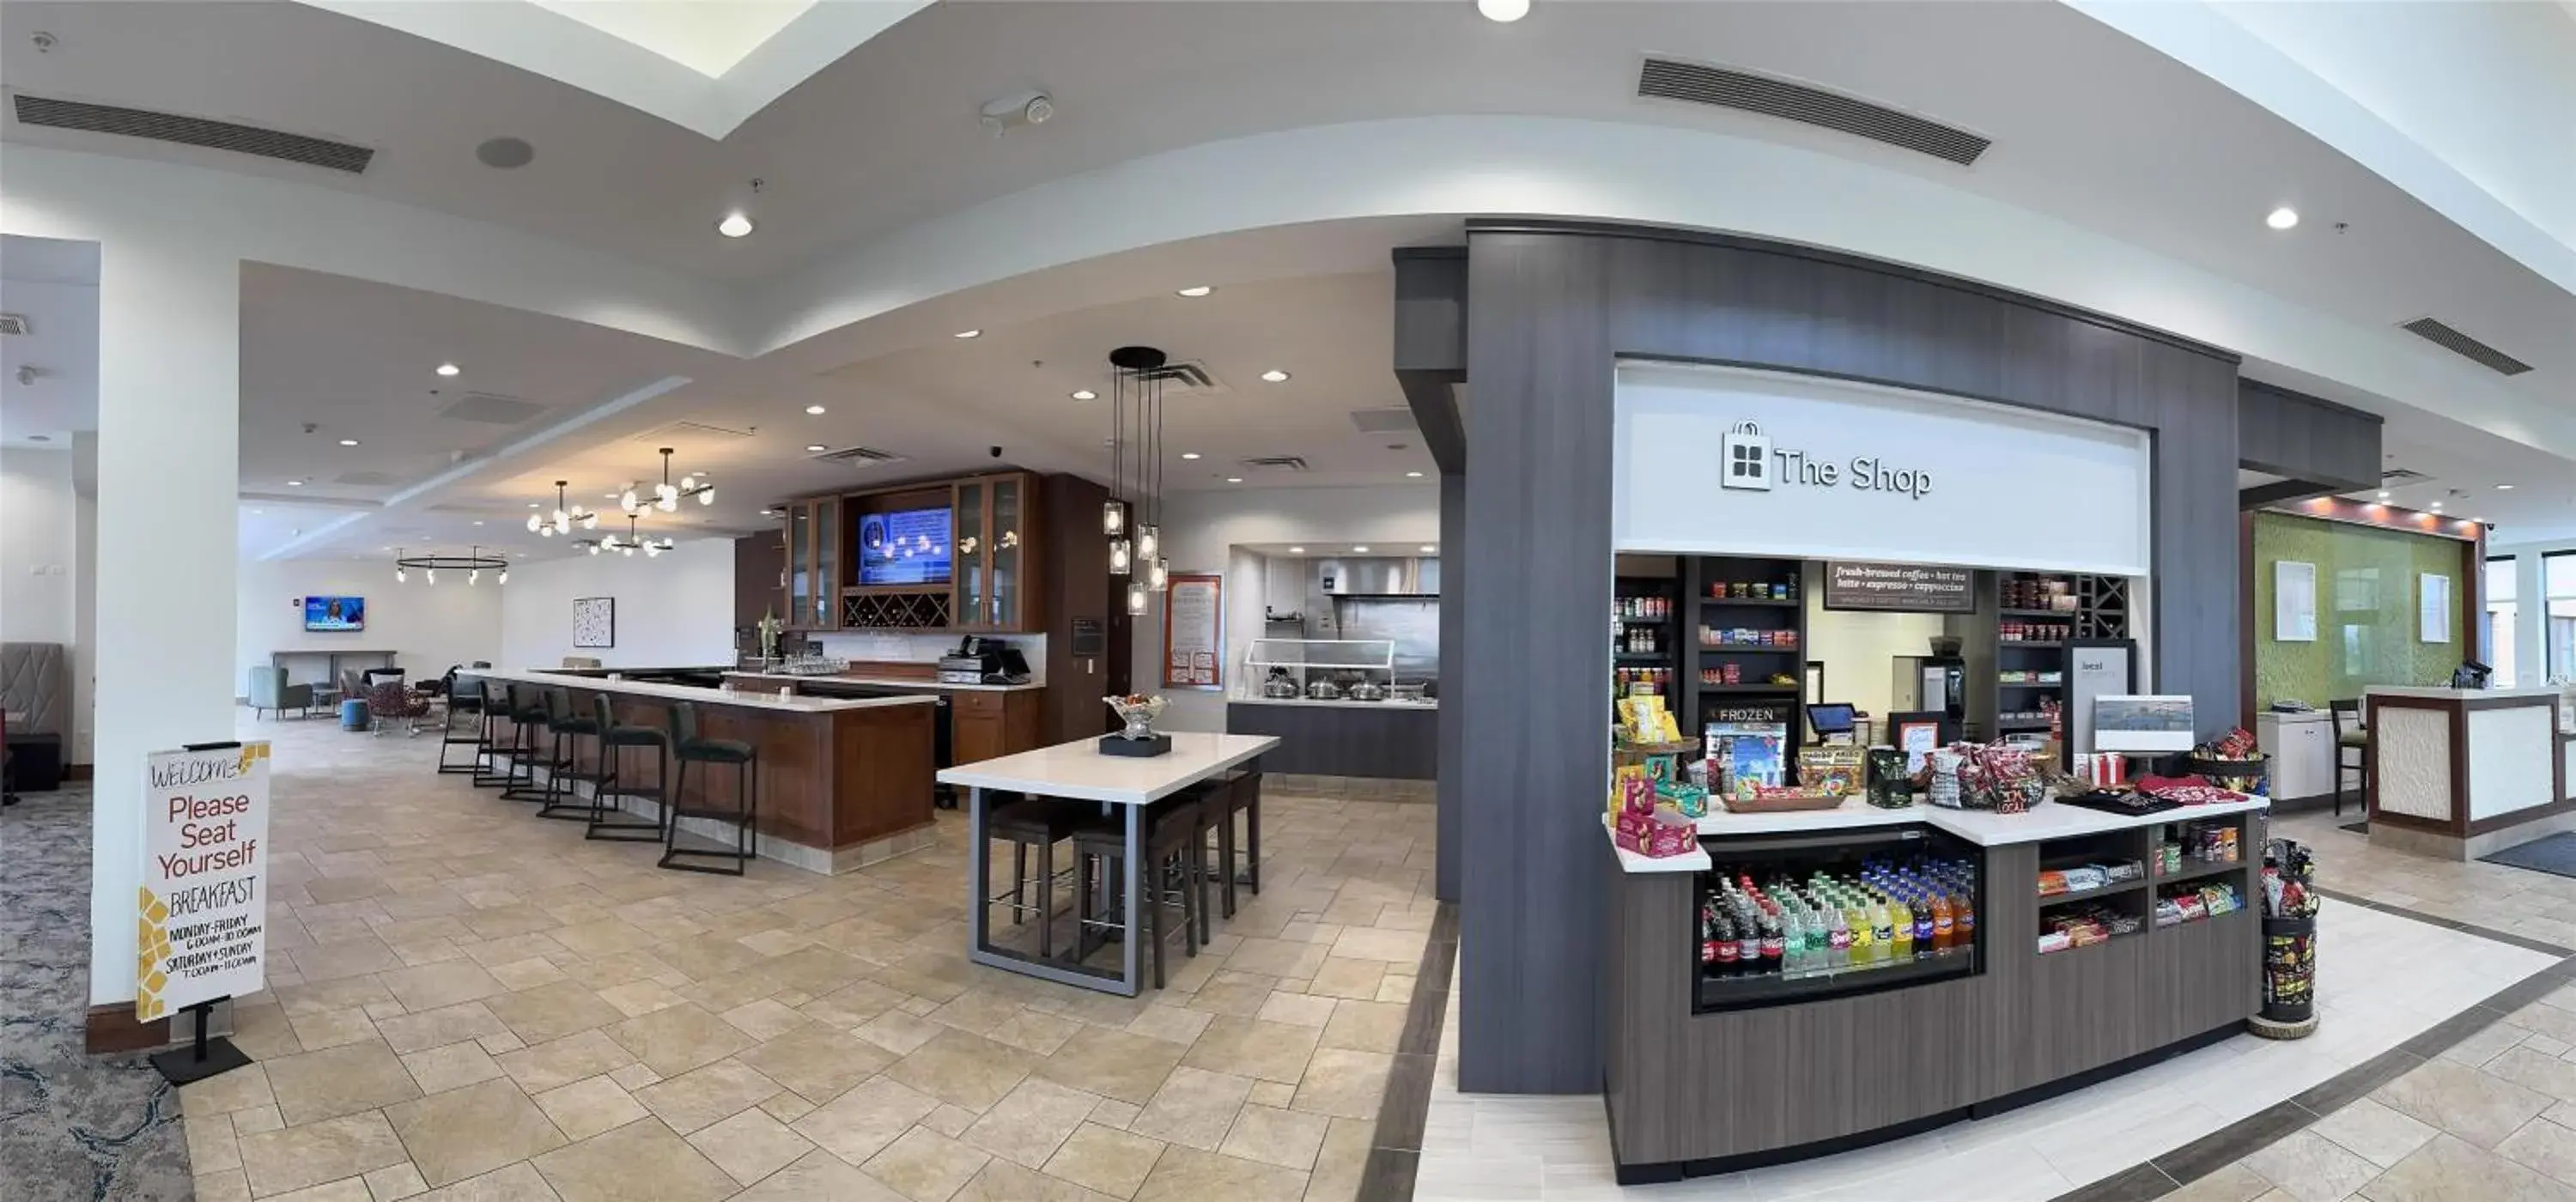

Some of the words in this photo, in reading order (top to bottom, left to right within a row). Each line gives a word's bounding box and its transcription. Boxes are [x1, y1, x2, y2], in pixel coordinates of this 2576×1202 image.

[1774, 448, 1839, 486] The
[1850, 456, 1933, 500] Shop
[1837, 579, 1860, 588] latte
[1903, 569, 1929, 580] coffee
[1935, 571, 1950, 580] hot
[1952, 572, 1966, 581] tea
[1720, 707, 1774, 721] FROZEN
[169, 794, 250, 823] Please
[180, 818, 237, 849] Seat
[157, 838, 257, 880] Yourself
[170, 875, 257, 918] BREAKFAST
